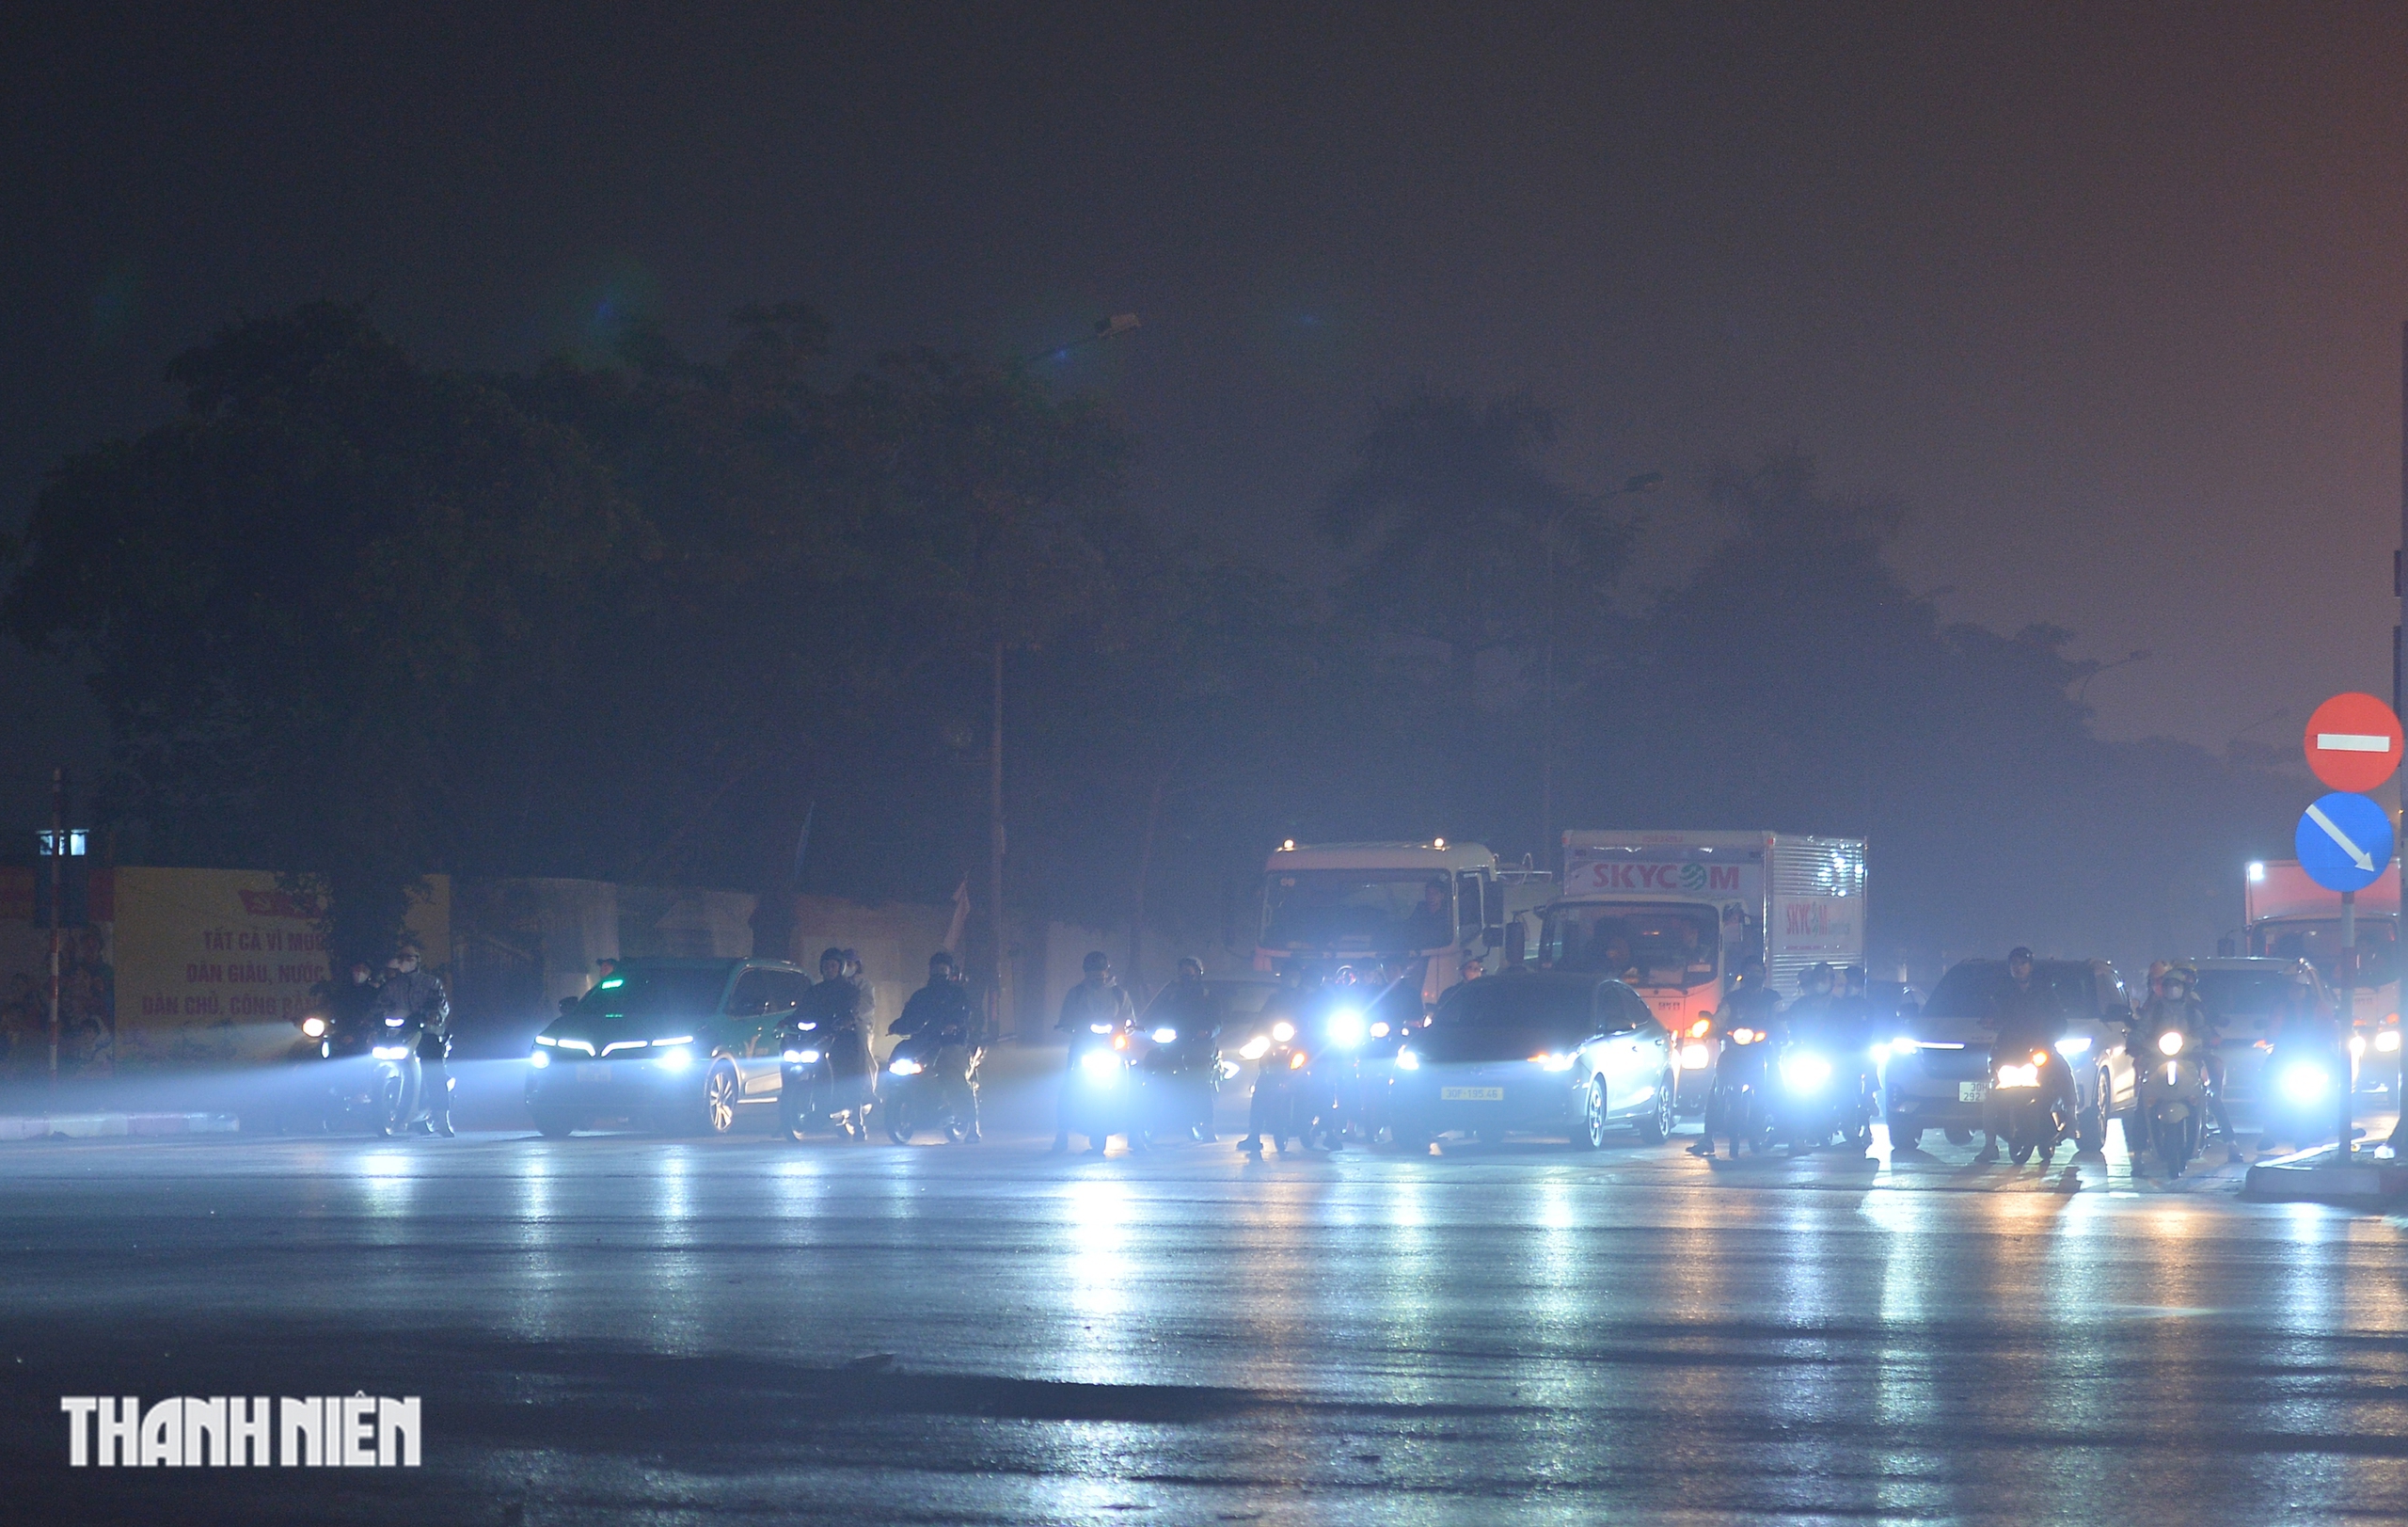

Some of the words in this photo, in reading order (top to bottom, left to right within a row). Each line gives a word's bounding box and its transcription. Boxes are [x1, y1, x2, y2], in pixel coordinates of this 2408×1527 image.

[1592, 863, 1739, 890] SKYCOM
[203, 926, 233, 951] TẤT
[239, 926, 261, 951] CẢ
[266, 928, 282, 951] VÌ
[186, 961, 222, 982] DÂN
[228, 961, 272, 985] GIÀU,
[142, 993, 179, 1015] DÂN
[230, 994, 277, 1015] CÔNG
